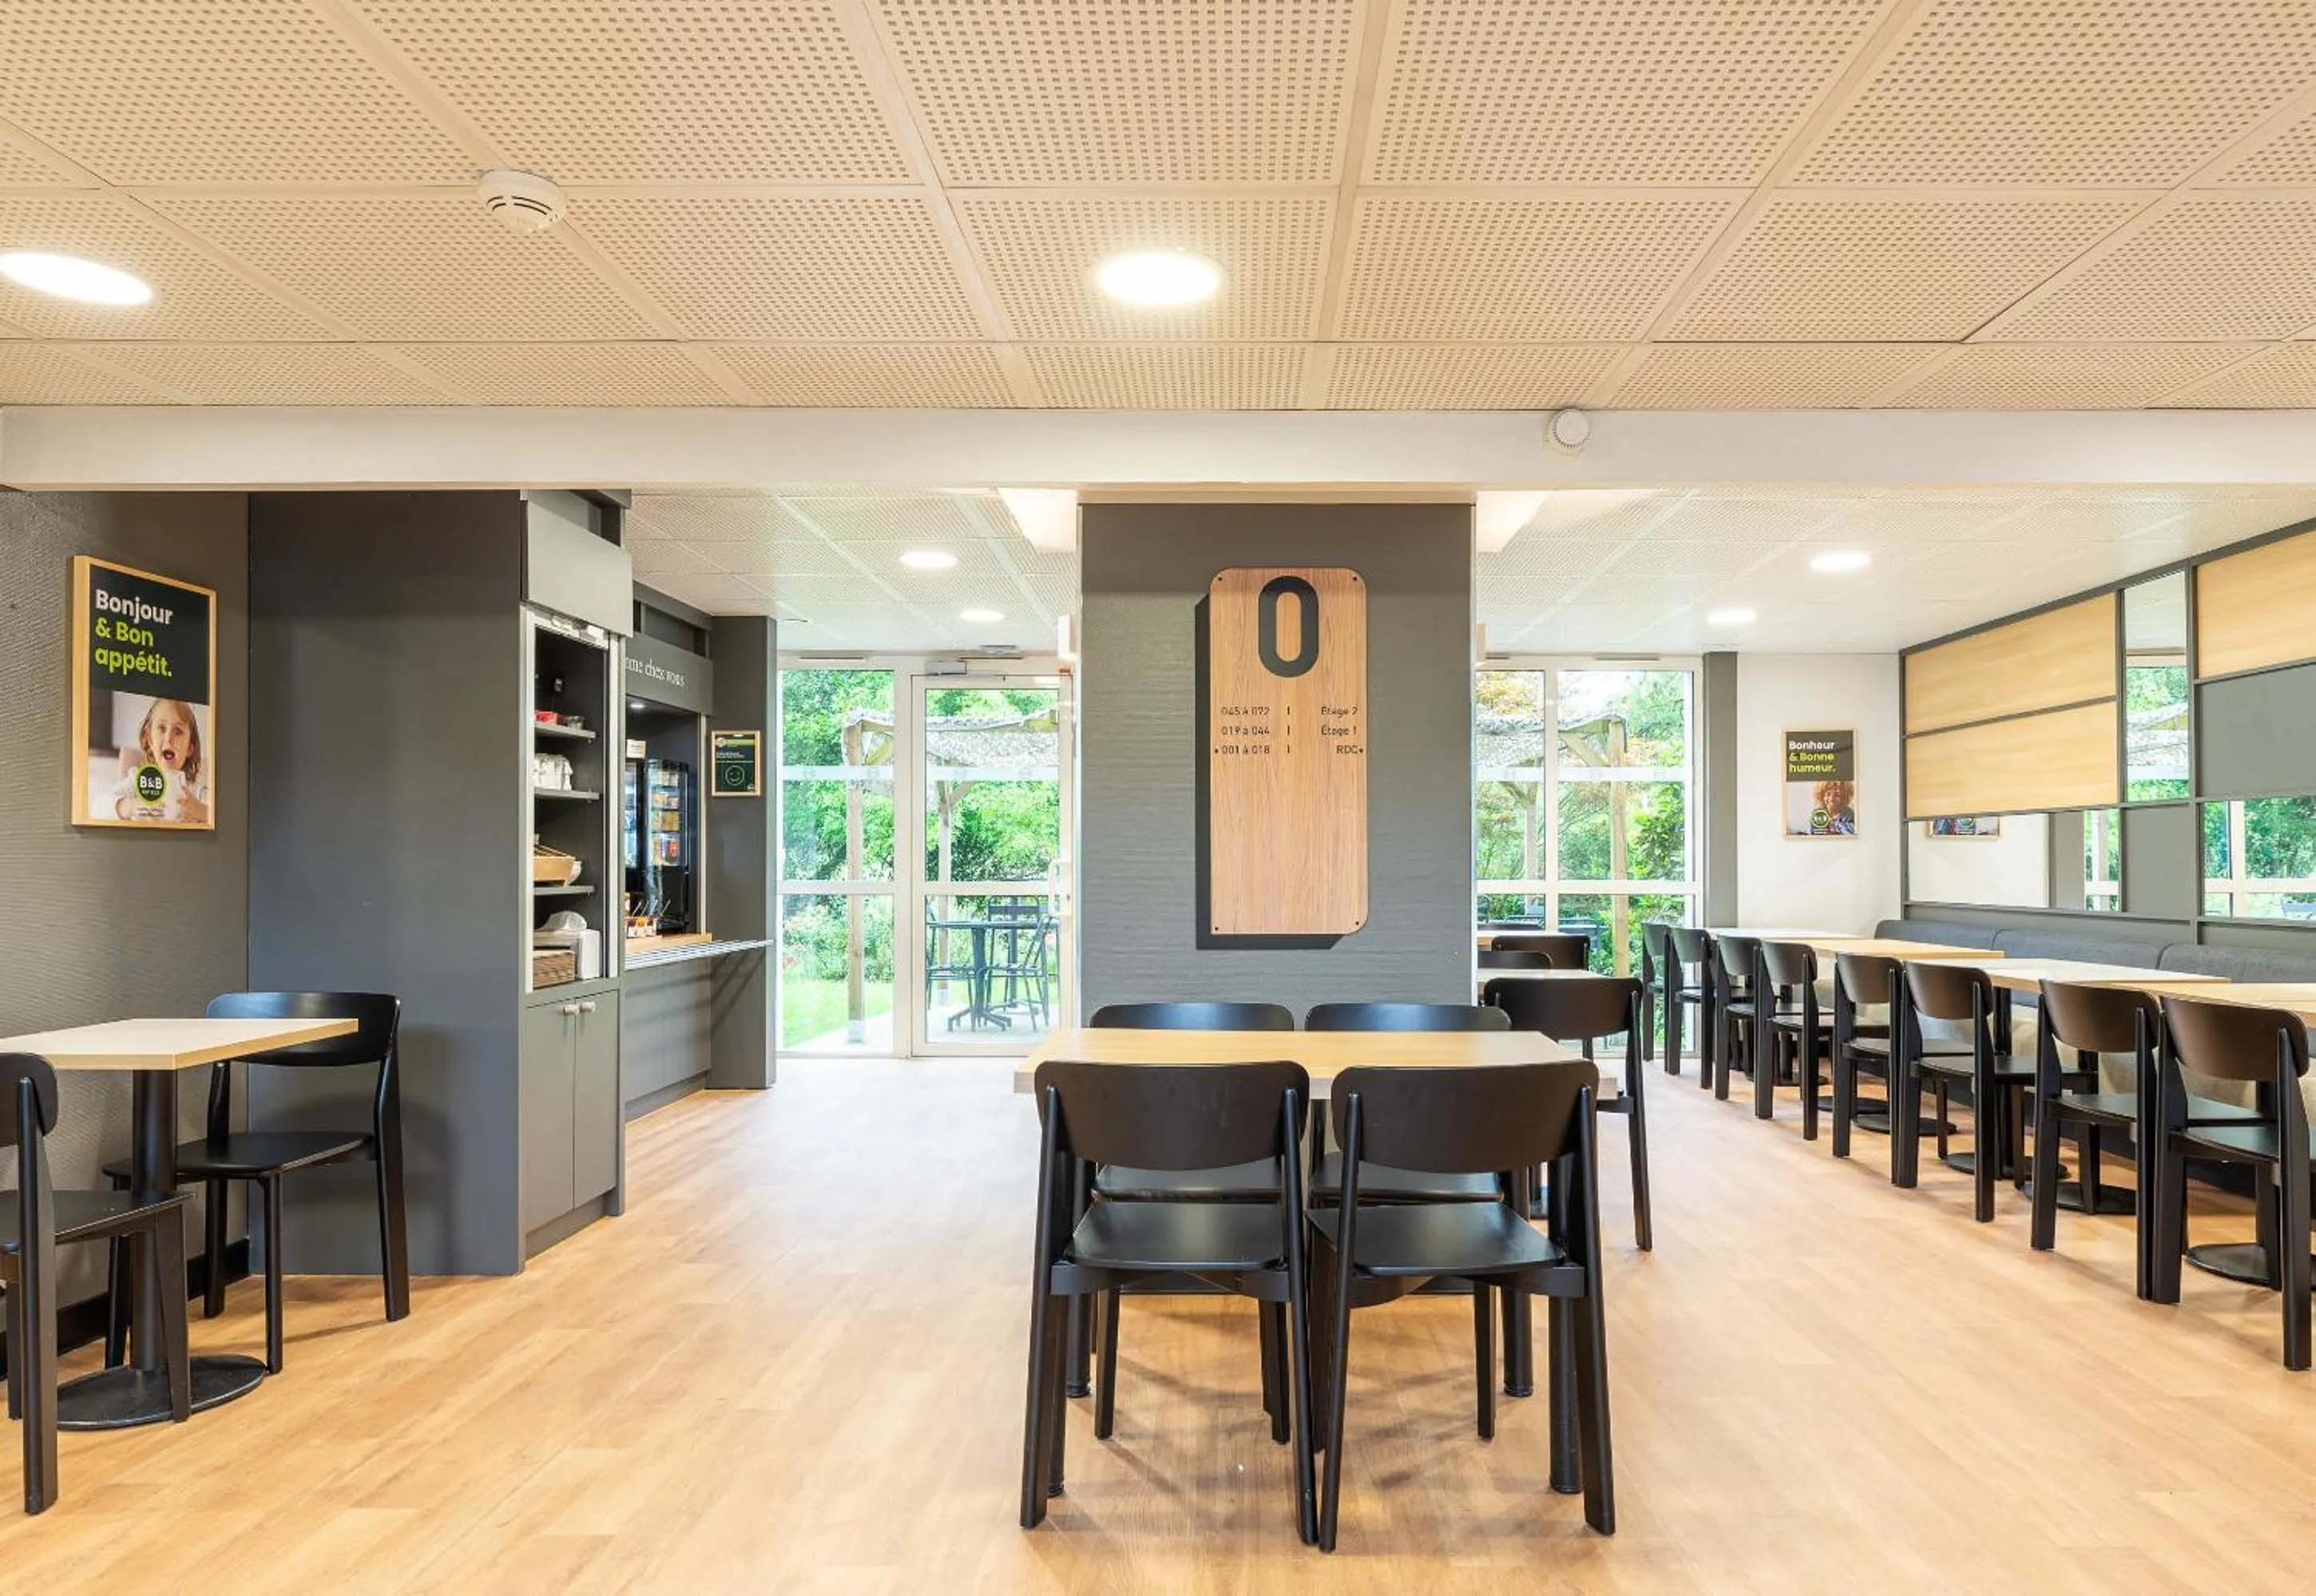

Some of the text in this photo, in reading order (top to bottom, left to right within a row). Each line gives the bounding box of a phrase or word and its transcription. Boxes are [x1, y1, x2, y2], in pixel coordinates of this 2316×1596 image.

[96, 589, 173, 624] Bonjour
[95, 617, 154, 648] & Bon
[95, 648, 173, 677] appétit.
[1221, 706, 1240, 715] 045
[1251, 706, 1271, 715] 072
[1321, 703, 1349, 719] Étage
[1351, 707, 1358, 715] 2
[1221, 726, 1240, 735] 019
[1251, 726, 1271, 735] 044
[1321, 723, 1349, 737] Étage
[1222, 745, 1240, 754] 001
[1251, 745, 1271, 754] 018
[1336, 746, 1358, 754] RDC
[1789, 741, 1835, 750] Bonheur
[1789, 752, 1834, 762] & Bonne
[1789, 763, 1836, 773] humeur.
[140, 775, 163, 790] B&B
